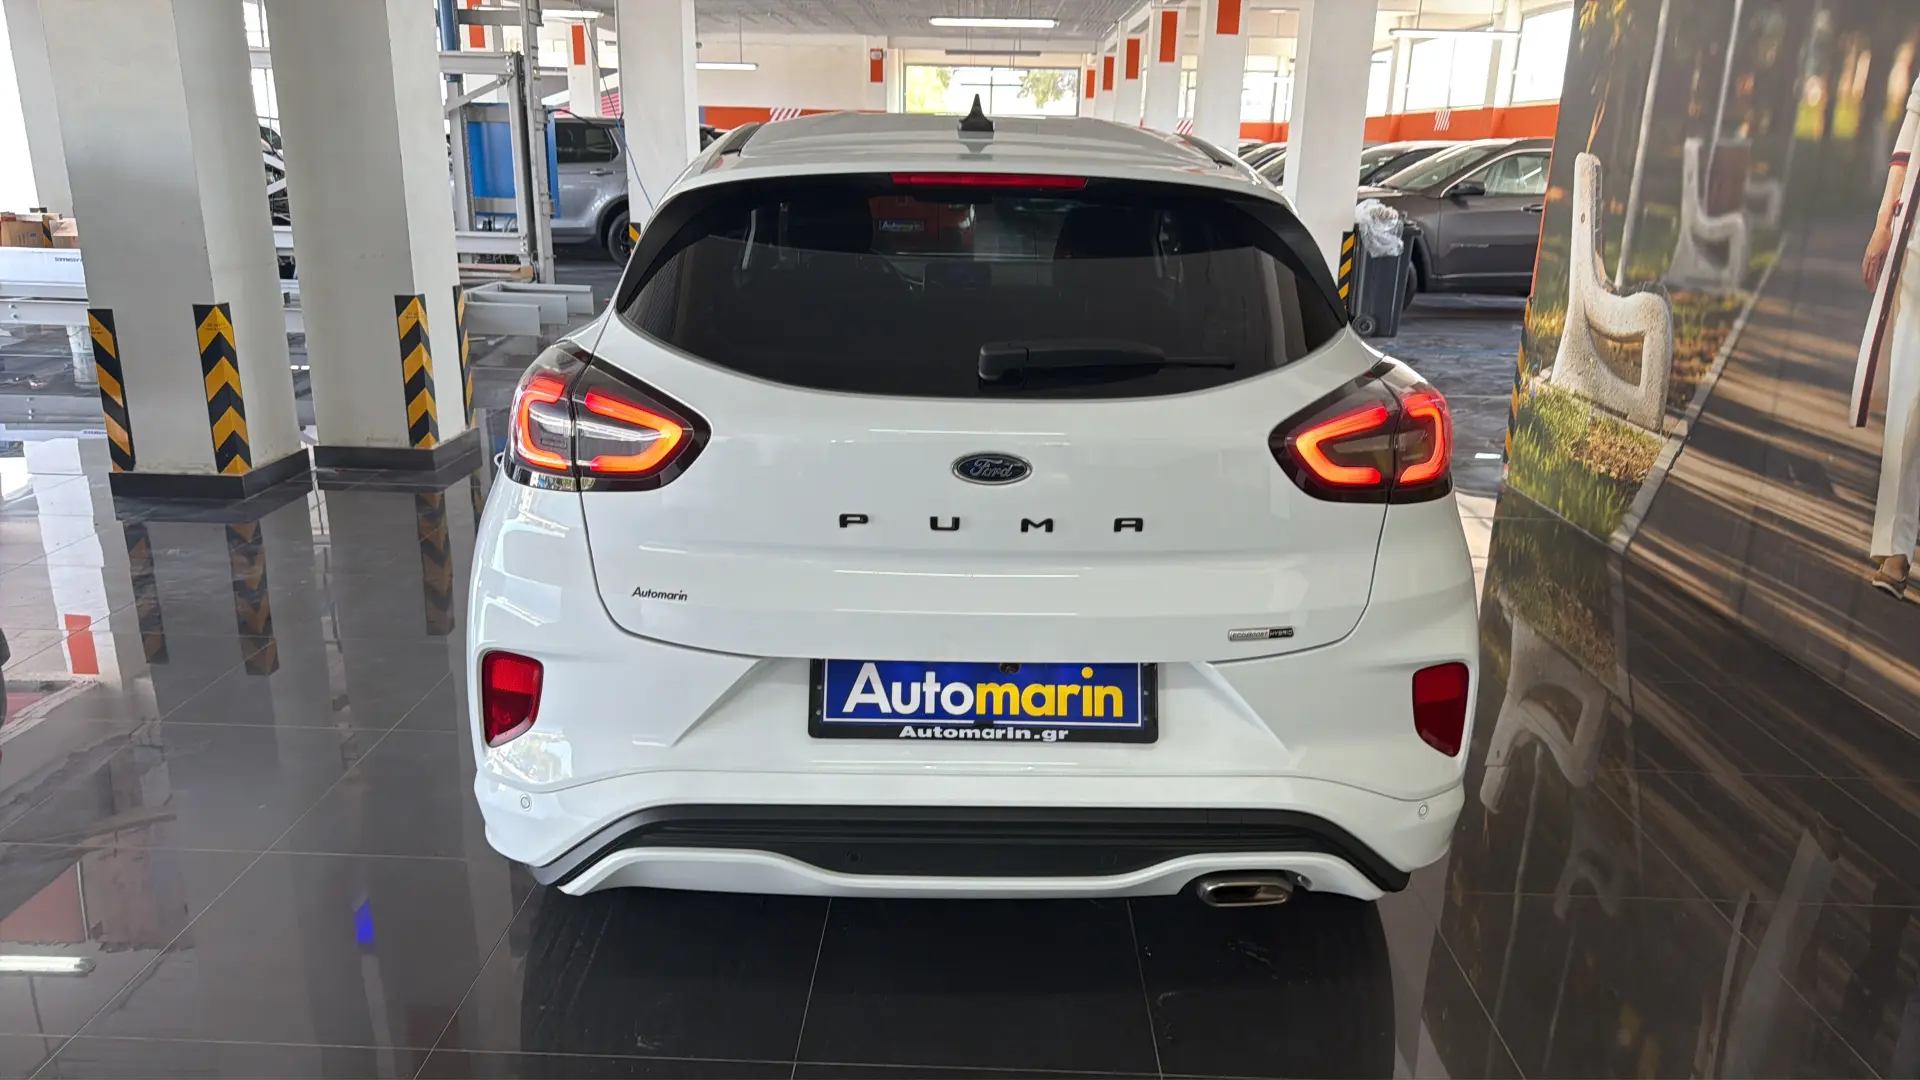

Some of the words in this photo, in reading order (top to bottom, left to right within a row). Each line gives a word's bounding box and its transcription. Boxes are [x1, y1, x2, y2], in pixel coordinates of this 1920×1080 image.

[969, 458, 1014, 477] Ford
[839, 513, 1144, 533] PUMA
[631, 586, 688, 601] Automarin
[842, 662, 1123, 717] Automarin
[899, 725, 1069, 742] Automarin.gr
